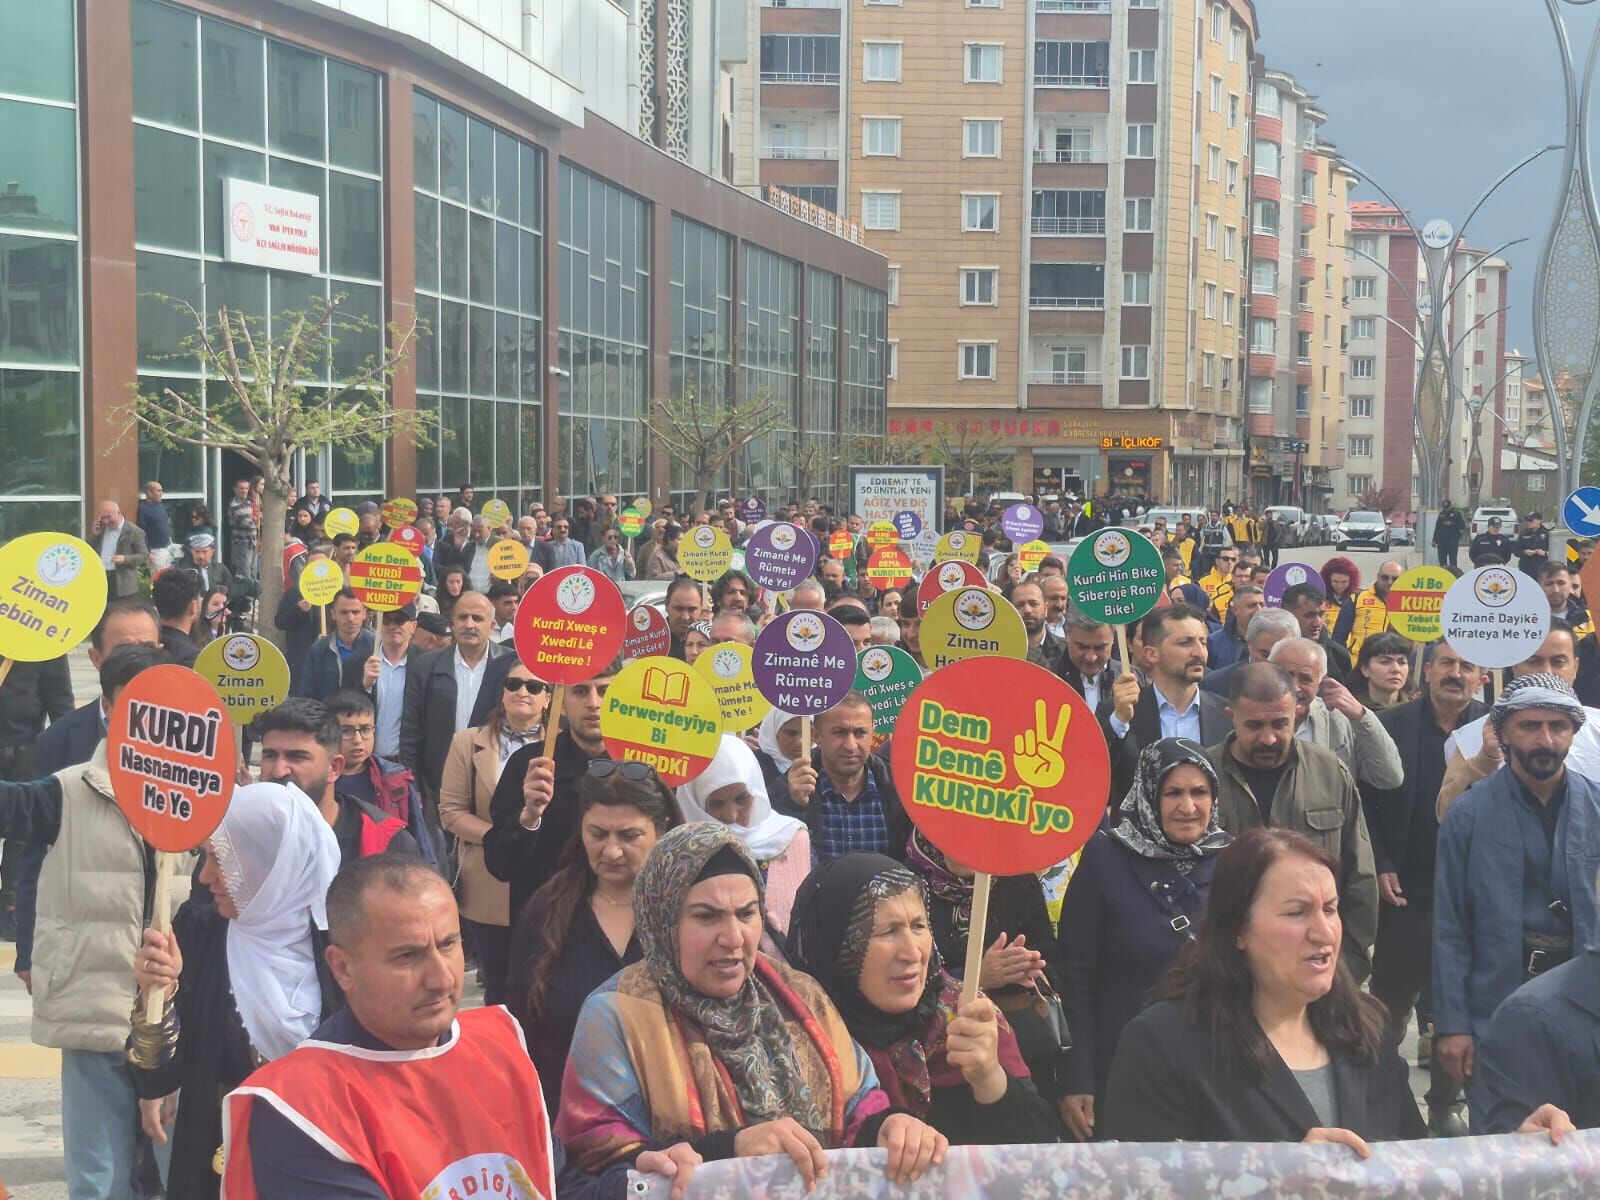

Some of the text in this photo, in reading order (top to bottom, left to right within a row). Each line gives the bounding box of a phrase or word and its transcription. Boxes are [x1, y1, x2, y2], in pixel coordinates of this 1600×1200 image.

[864, 496, 892, 507] AĞIZ
[895, 498, 908, 508] VE
[364, 552, 409, 566] Her Dem
[754, 548, 806, 564] Zimanê Me
[368, 566, 402, 579] KURDÎ
[759, 562, 796, 576] Rûmeta
[365, 578, 404, 590] Her Der
[760, 576, 792, 588] Me Ye!
[1074, 568, 1158, 586] Kurdî Hîn Bike
[1412, 578, 1443, 590] Ji Bo
[11, 576, 70, 614] Ziman
[366, 591, 400, 604] KURDÎ
[1078, 583, 1157, 602] Siberojê Ronî
[1104, 602, 1135, 616] Bike!
[1400, 596, 1440, 611] KURD
[0, 602, 44, 632] ebûn
[1452, 612, 1538, 626] Zimanê Dayikê
[532, 617, 608, 634] Kurdî Xweş e
[1448, 627, 1542, 640] Mîrateya Me Ye!
[540, 634, 594, 650] Xwedî Lê
[947, 633, 999, 652] Ziman
[537, 651, 592, 666] Derkeve !
[764, 652, 846, 669] Zimanê Me
[217, 674, 264, 687] Ziman
[776, 672, 833, 689] Rûmeta
[880, 682, 906, 694] Xweş
[908, 680, 914, 688] e
[260, 694, 274, 706] e!
[778, 694, 828, 708] Me Ye!
[609, 698, 717, 734] Perwerdeyîya
[735, 709, 747, 718] Ye
[921, 701, 990, 742] Dem
[128, 701, 221, 758] KURDÎ
[650, 726, 667, 744] Bi
[918, 738, 1004, 780] Demê
[120, 745, 221, 795] Nasnameya
[144, 784, 192, 819] Me Ye
[915, 774, 1071, 832] KURDKÎ yo
